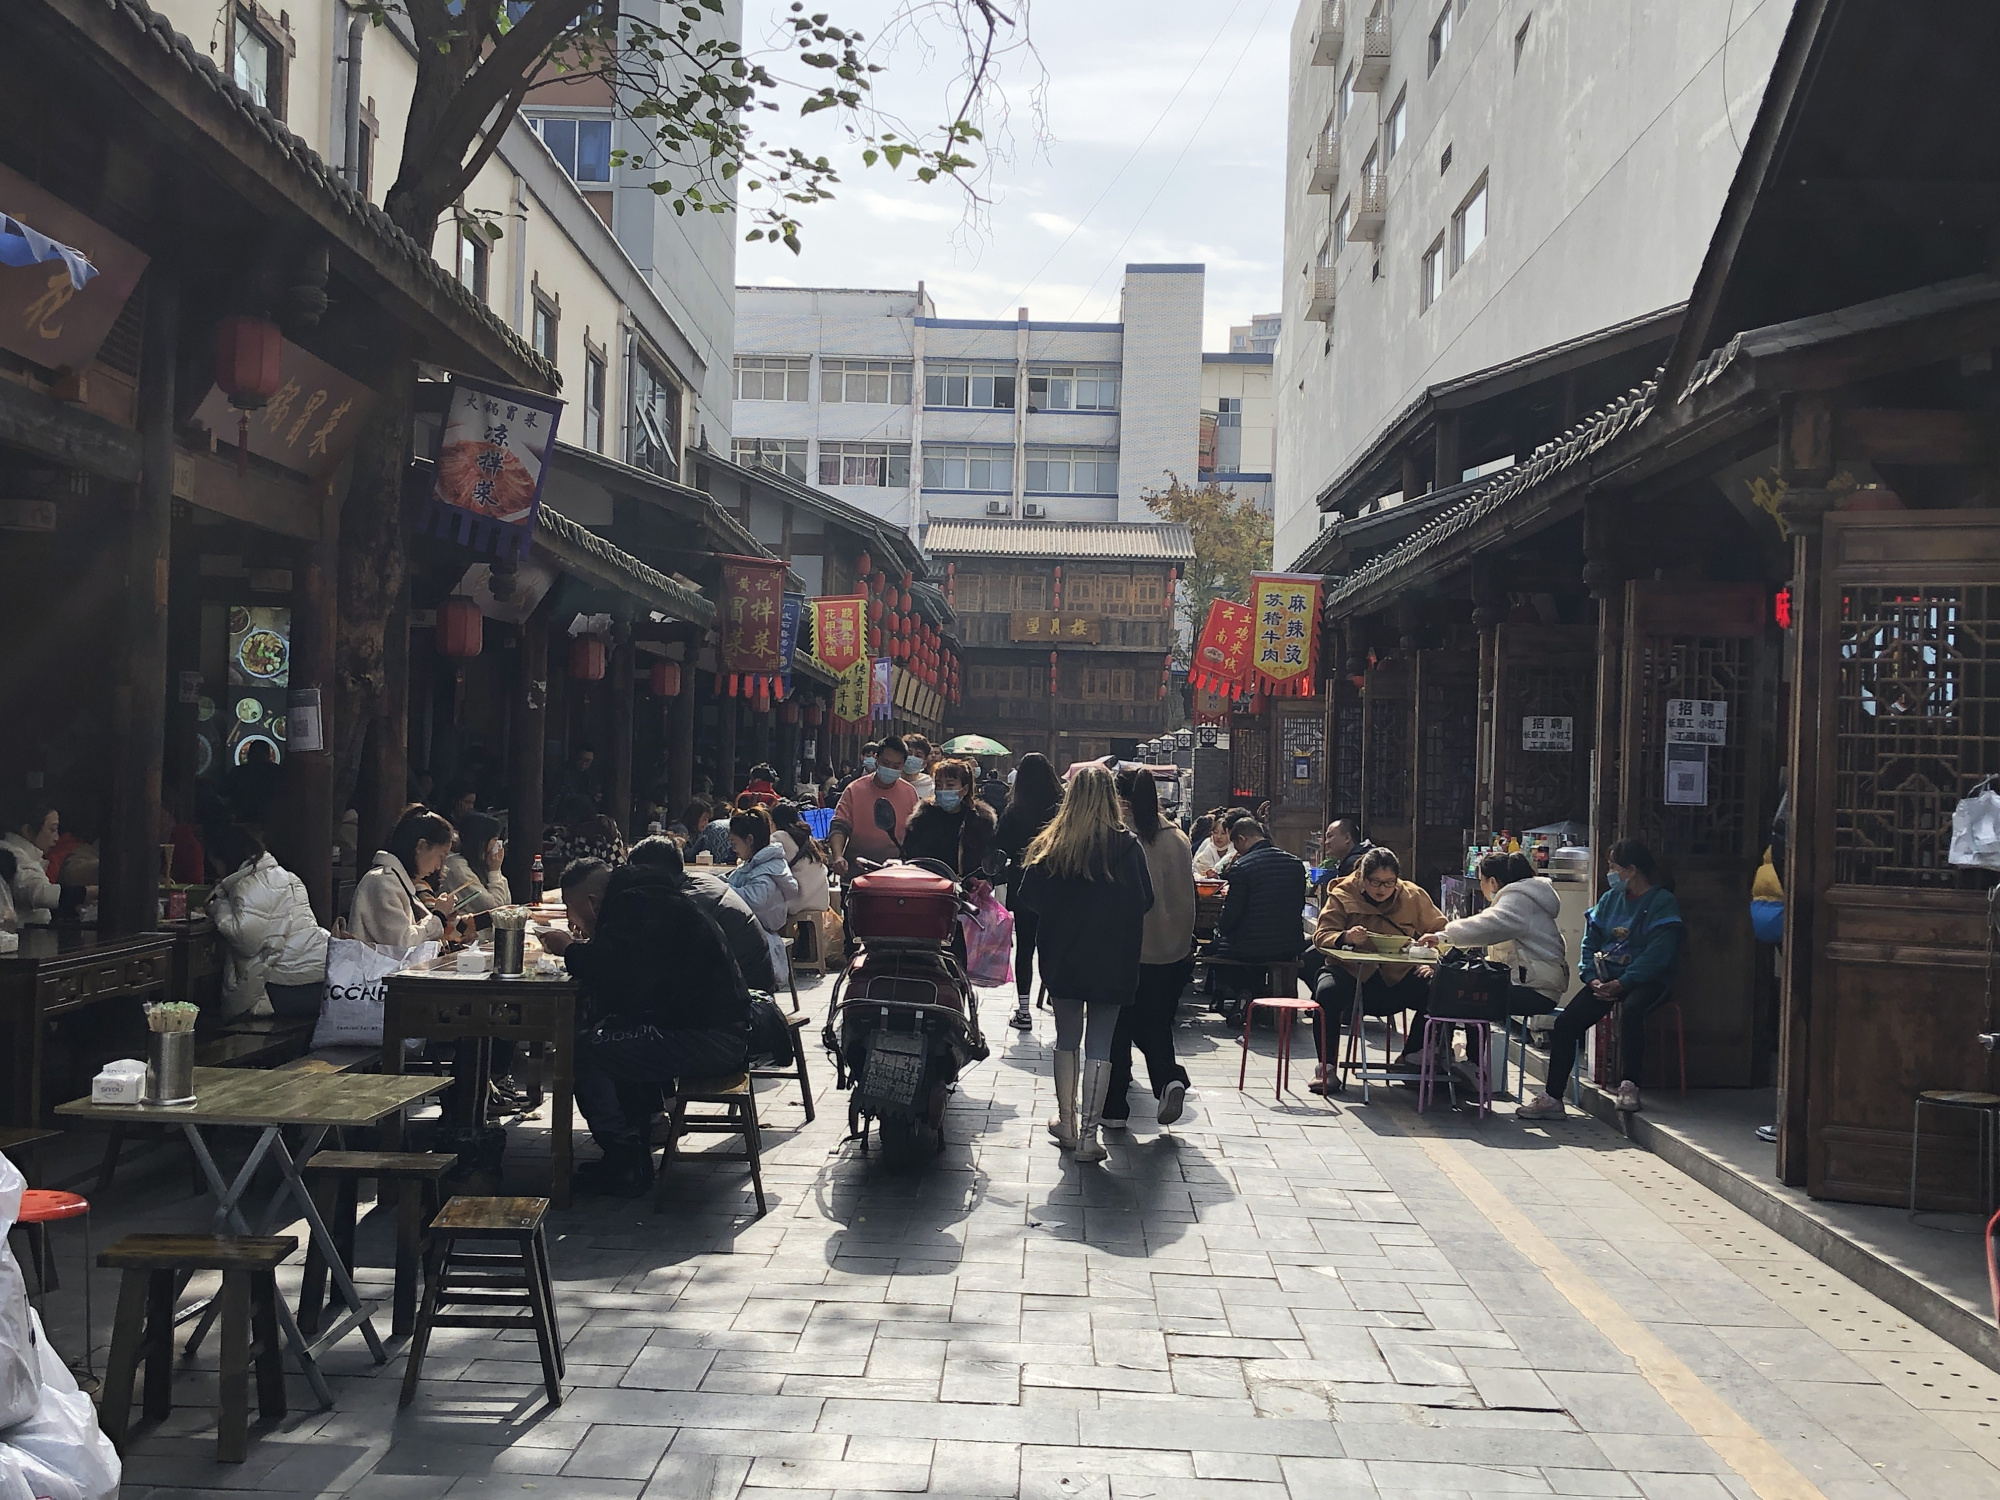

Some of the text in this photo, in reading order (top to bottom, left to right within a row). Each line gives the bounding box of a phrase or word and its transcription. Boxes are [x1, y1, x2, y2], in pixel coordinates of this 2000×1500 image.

[465, 394, 538, 428] 火锅冒菜
[472, 423, 509, 506] 凉拌菜
[736, 575, 771, 592] 黄记
[726, 597, 750, 657] 冒菜
[750, 596, 776, 659] 拌菜
[825, 608, 837, 657] 花甲米线
[1214, 606, 1236, 646] 云南
[1223, 612, 1253, 674] 土鸡米线
[1261, 593, 1284, 664] 苏稽牛肉
[1284, 594, 1307, 665] 麻辣烫
[852, 664, 866, 717] 传奇冒菜
[1678, 701, 1715, 717] 招聘
[1524, 731, 1571, 740] 长期工 小时工
[1532, 718, 1563, 730] 招聘
[1668, 718, 1725, 730] 长期工 小时工
[1675, 732, 1717, 743] 工资面议
